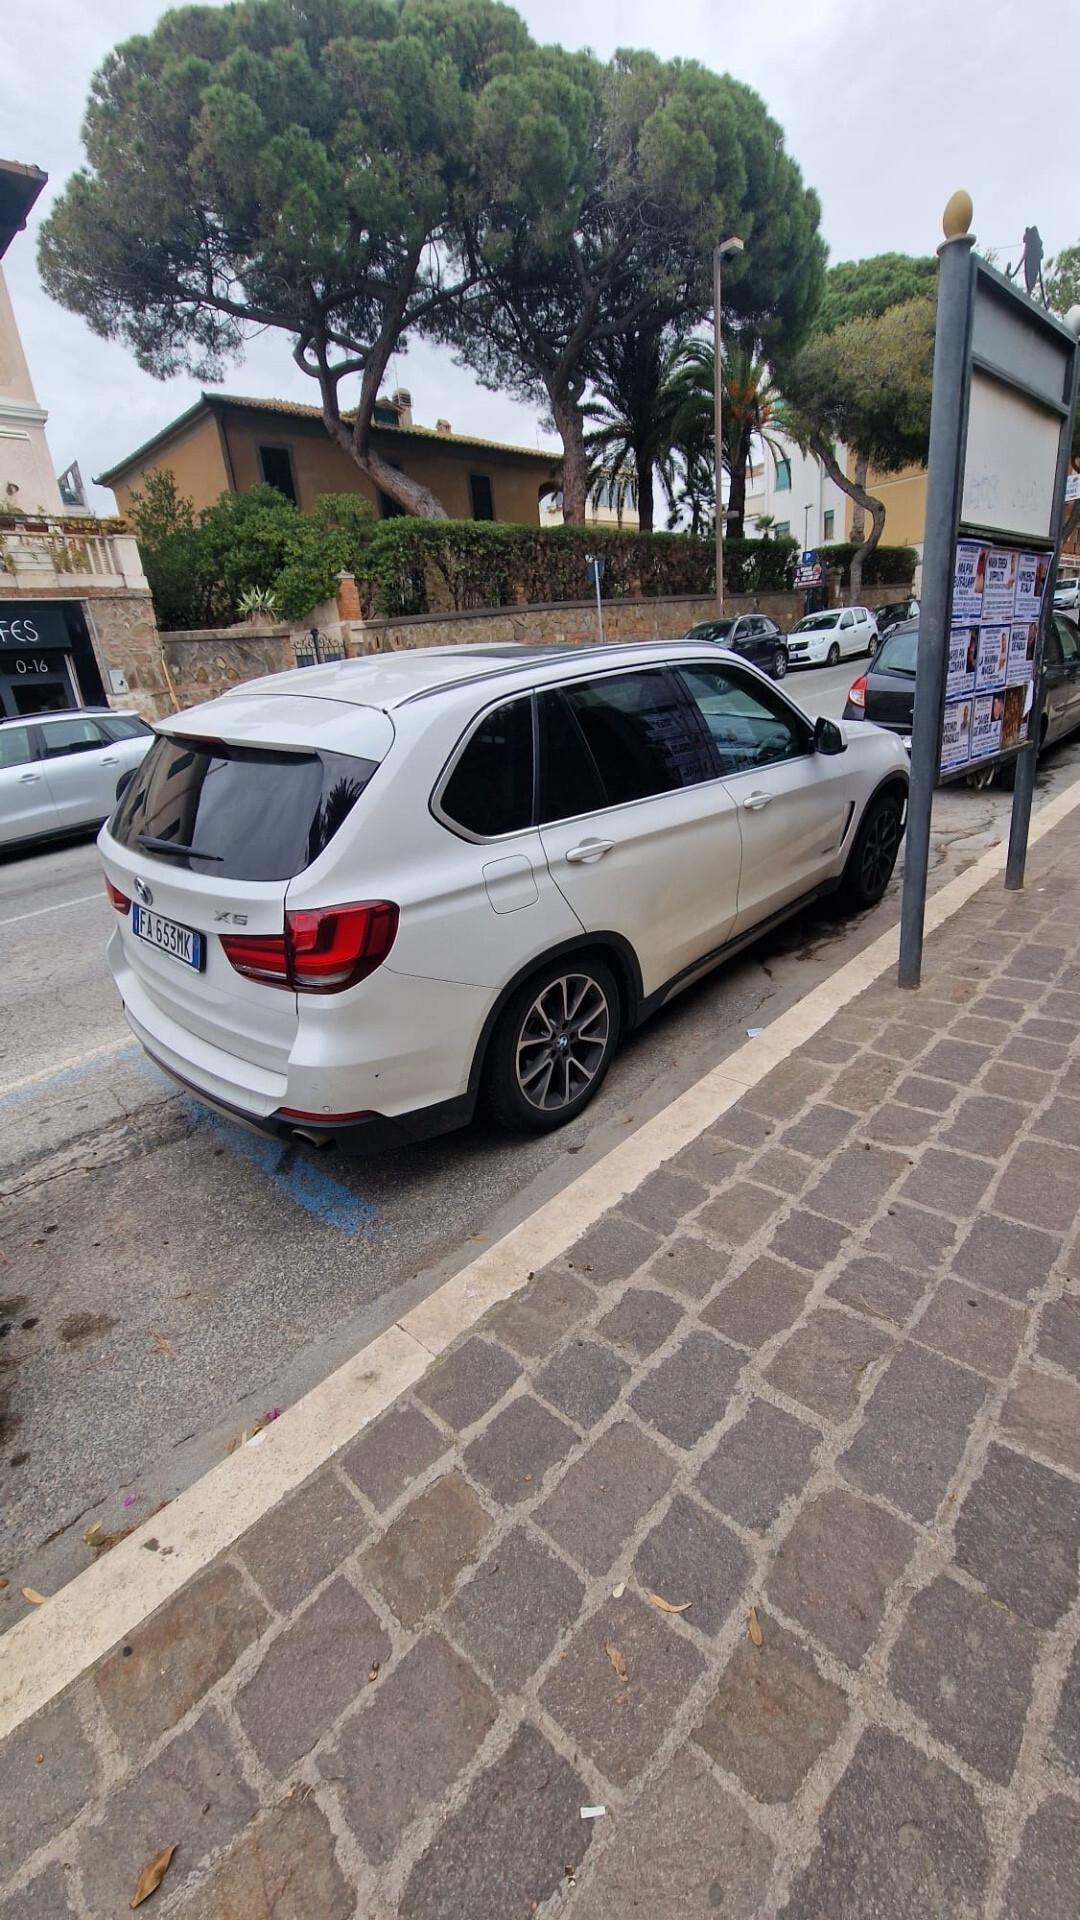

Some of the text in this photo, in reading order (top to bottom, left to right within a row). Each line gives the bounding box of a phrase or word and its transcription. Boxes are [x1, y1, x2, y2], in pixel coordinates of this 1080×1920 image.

[805, 552, 812, 560] P
[16, 659, 48, 673] 0-16
[140, 909, 191, 960] FA 653MK
